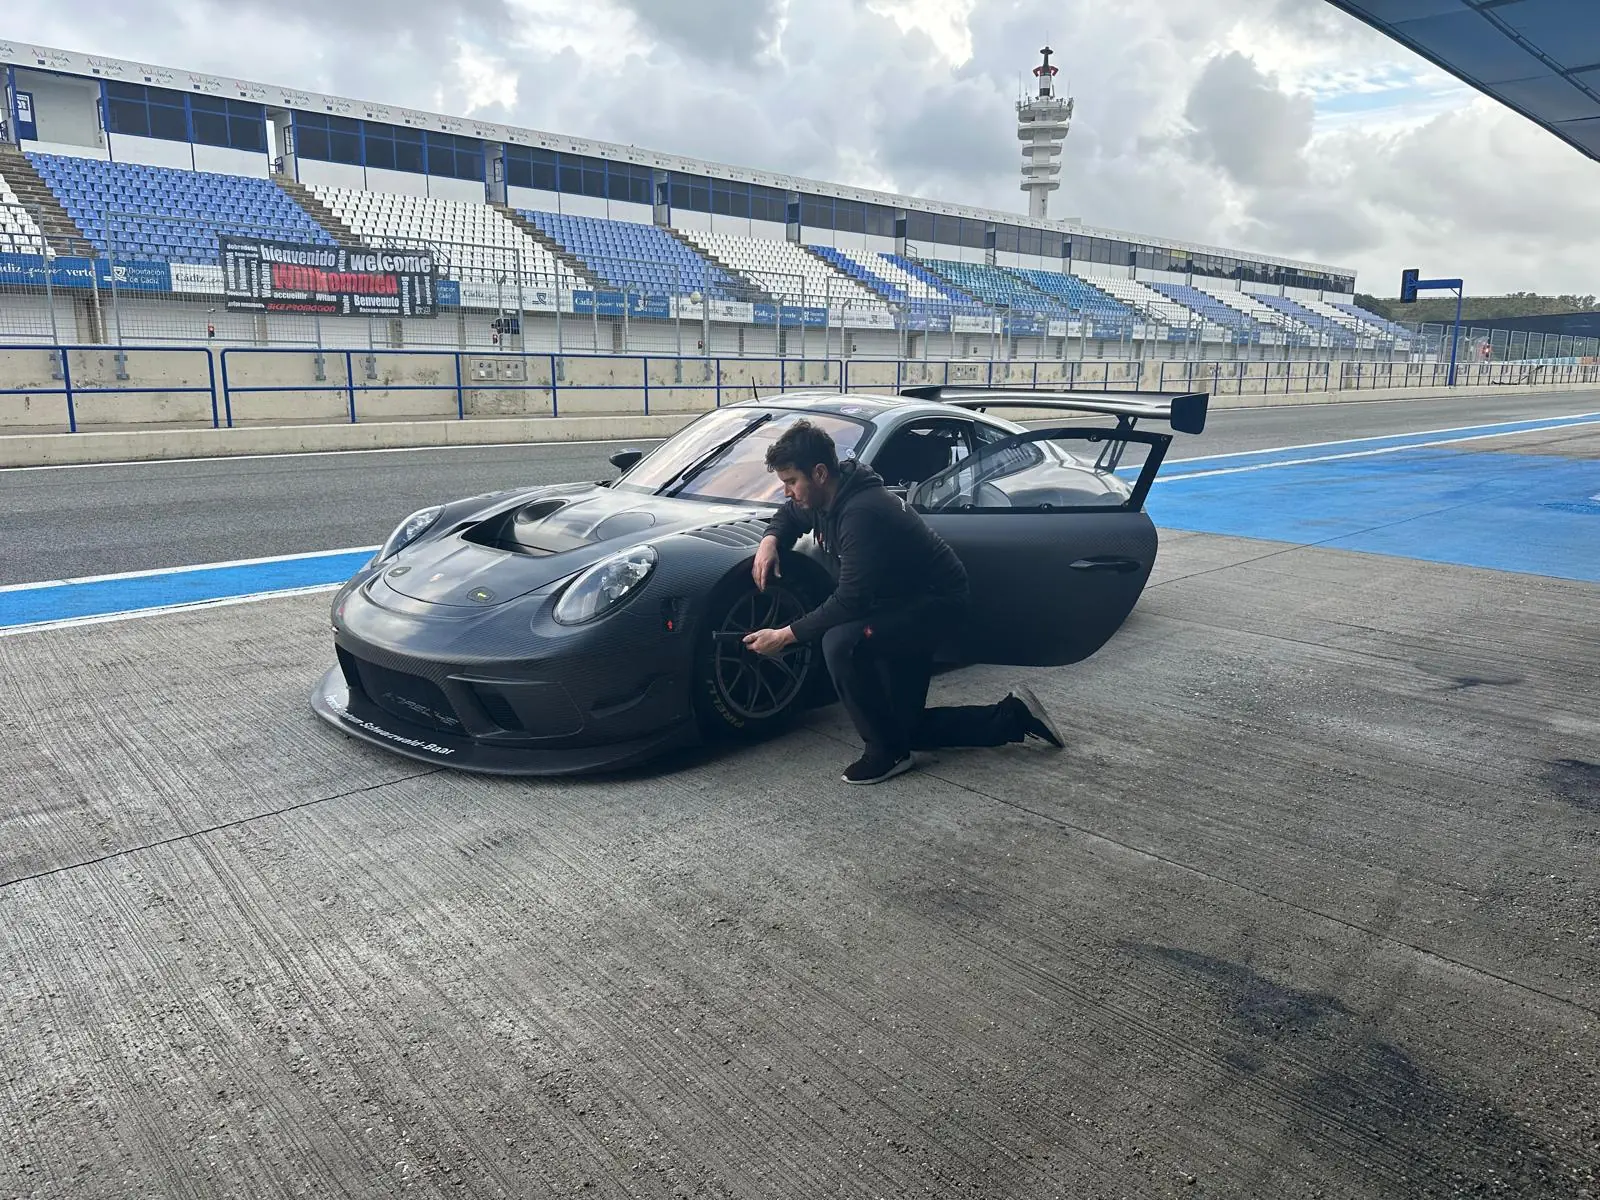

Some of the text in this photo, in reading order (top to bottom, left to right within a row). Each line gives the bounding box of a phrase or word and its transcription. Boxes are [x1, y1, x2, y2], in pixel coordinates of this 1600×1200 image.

[260, 244, 336, 267] bienvenido
[350, 252, 431, 273] welcome
[261, 263, 271, 298] Welkom
[272, 264, 398, 294] Willkommen
[315, 293, 337, 302] Witam
[353, 294, 400, 308] Benvenuto
[706, 679, 745, 729] PIRELLI
